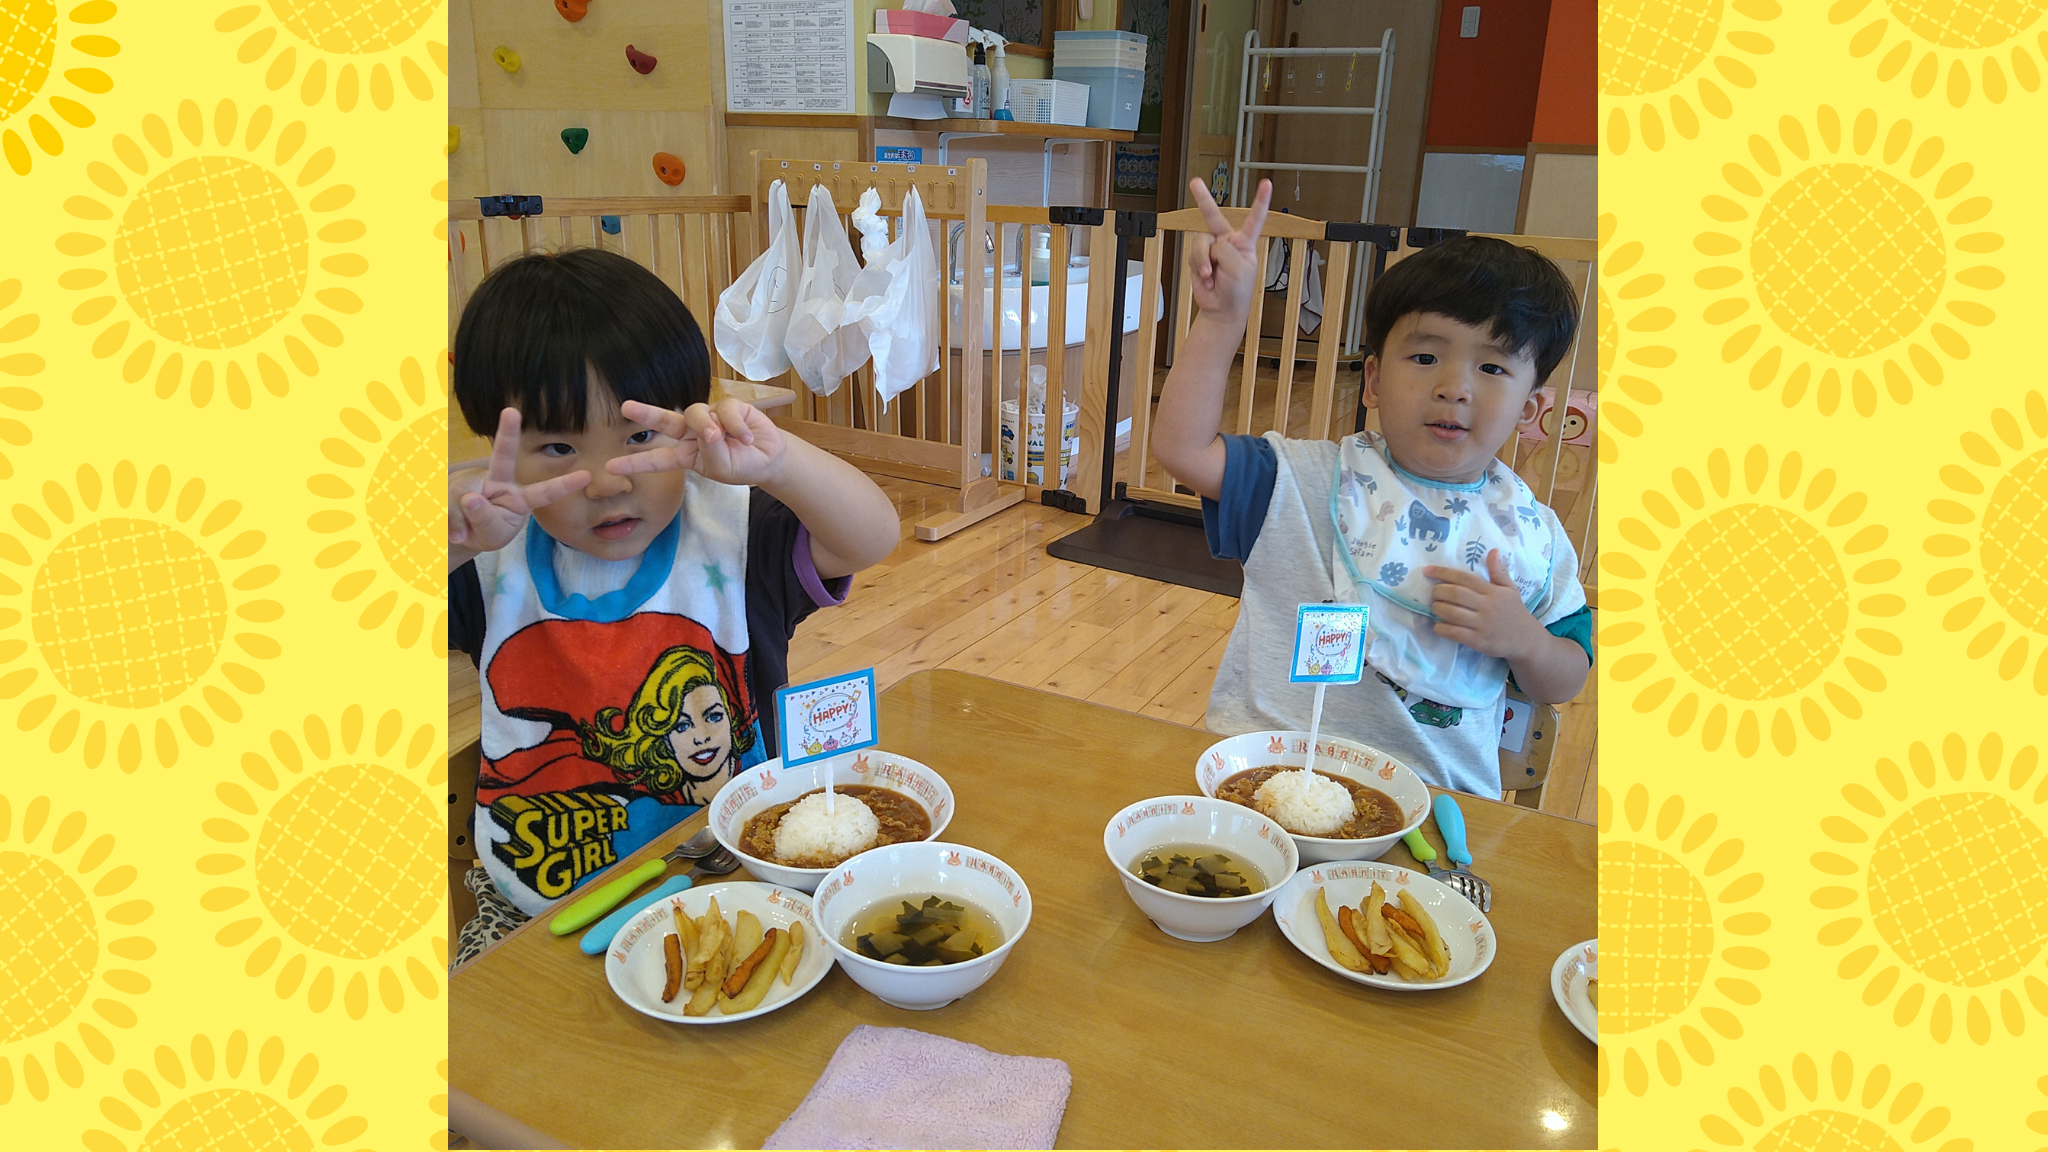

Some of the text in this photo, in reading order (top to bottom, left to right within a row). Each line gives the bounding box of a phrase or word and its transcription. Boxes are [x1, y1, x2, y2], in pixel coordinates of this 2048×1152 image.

[1319, 632, 1348, 646] HAPPY!
[813, 703, 852, 725] HAPPY!
[1298, 741, 1372, 767] RABBIT
[882, 764, 936, 801] RABBIT
[1128, 804, 1174, 826] RABBIT
[511, 802, 629, 870] SUPER
[535, 834, 618, 900] GIRL
[970, 857, 1014, 889] RABBIT
[1331, 868, 1386, 879] RABBIT
